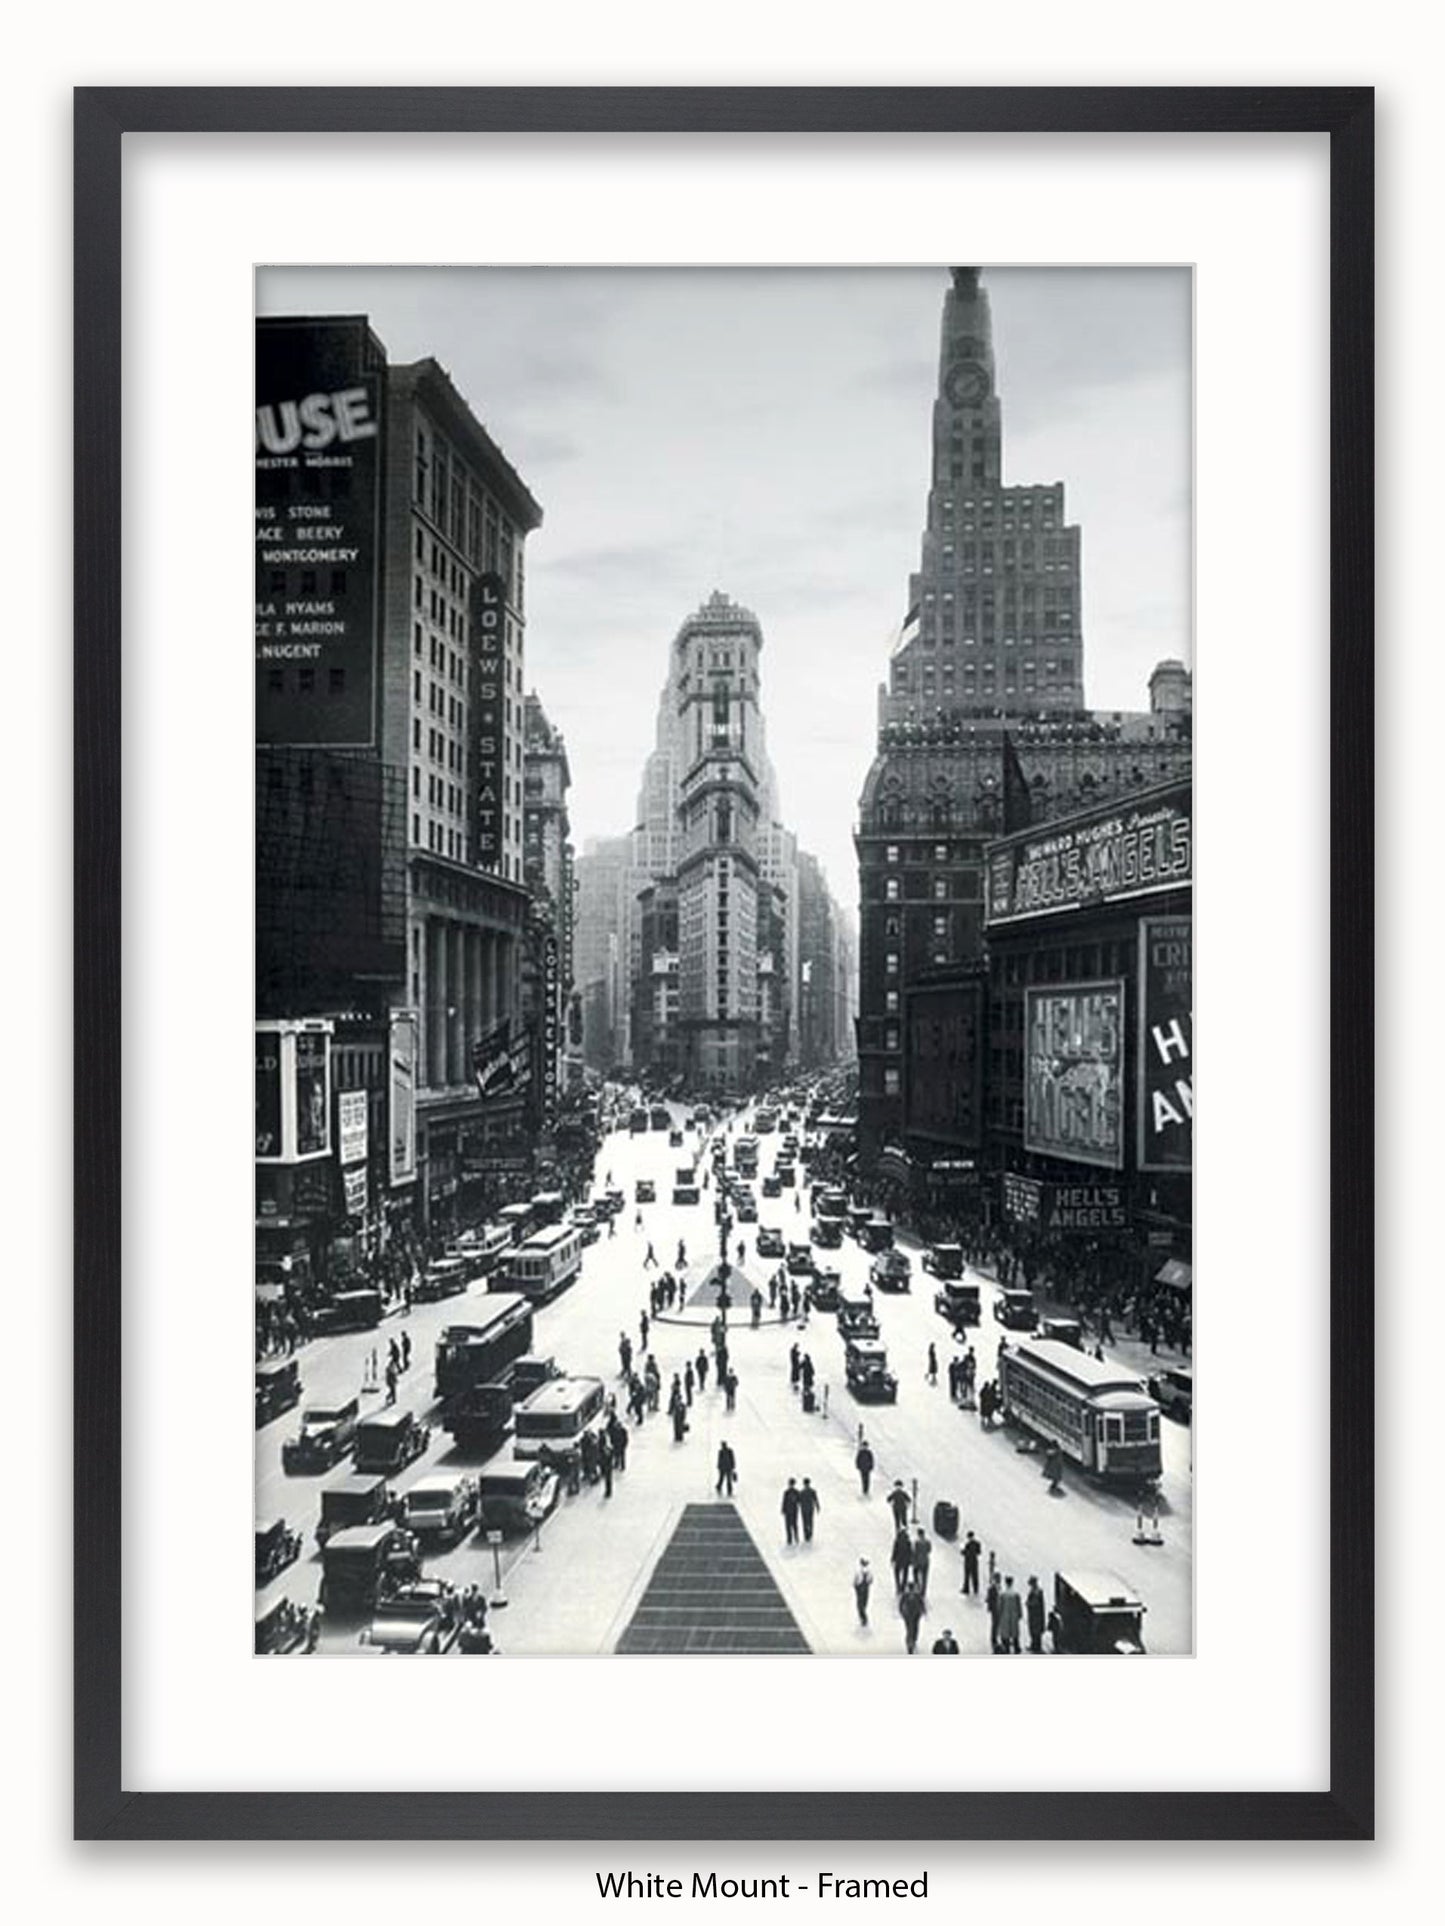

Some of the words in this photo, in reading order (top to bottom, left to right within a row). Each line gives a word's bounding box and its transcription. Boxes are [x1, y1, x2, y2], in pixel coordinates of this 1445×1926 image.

[255, 387, 378, 454] USE
[288, 505, 331, 519] STONE
[296, 525, 344, 540] BEERY
[262, 547, 360, 562] MONTGOMERY
[290, 620, 345, 635] MARION
[479, 736, 499, 851] STATE
[1083, 816, 1191, 894] ANGELS
[1050, 1207, 1127, 1228] ANGELS
